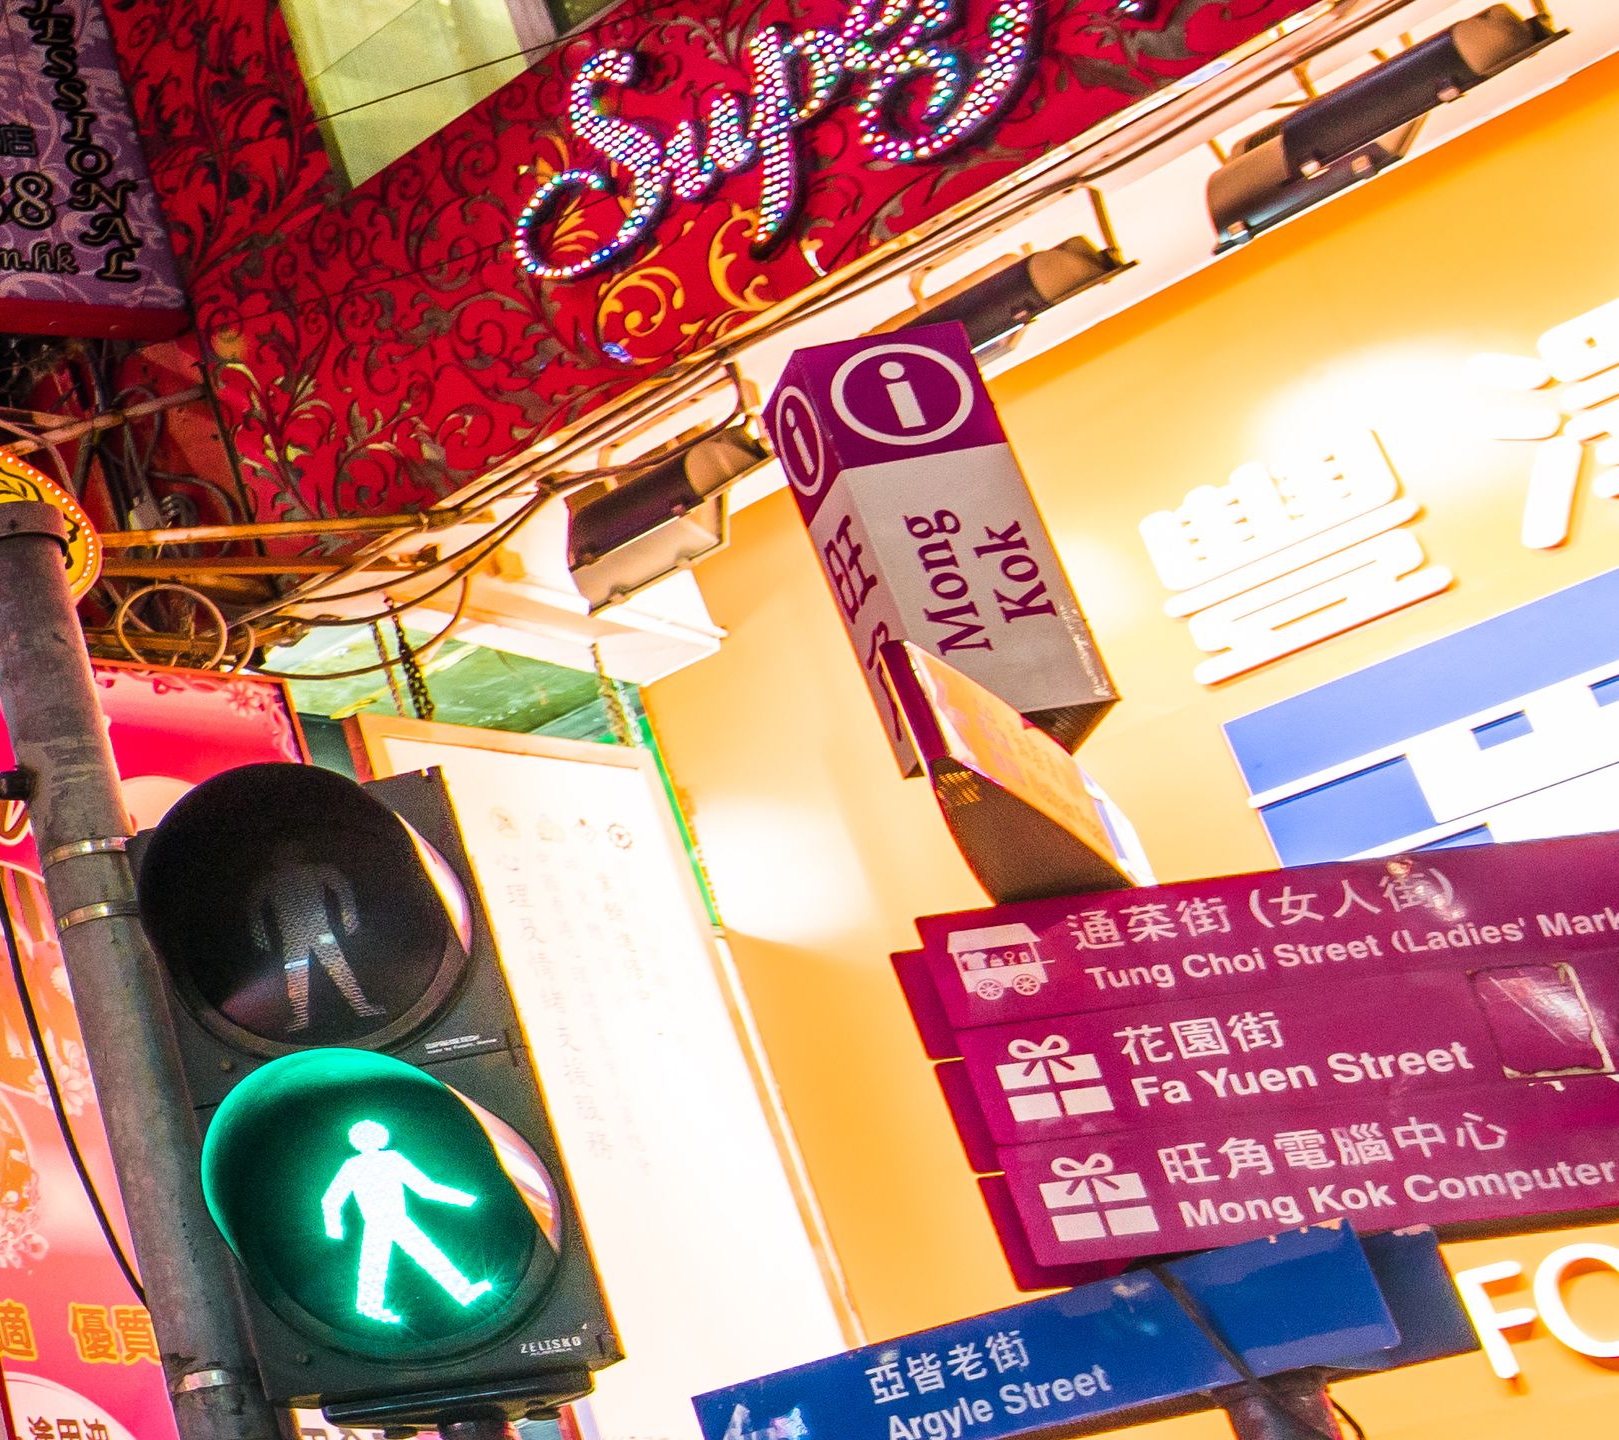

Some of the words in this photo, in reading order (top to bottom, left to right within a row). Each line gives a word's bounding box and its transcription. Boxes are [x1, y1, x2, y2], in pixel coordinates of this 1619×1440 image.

[902, 508, 993, 656] Mong
[975, 519, 1059, 622] Kok
[1083, 957, 1175, 992] Tung
[1180, 948, 1266, 985] Choi
[1273, 933, 1384, 971] Street
[1390, 917, 1530, 958] (Ladies'
[1113, 1011, 1285, 1065] 花園街
[1130, 1071, 1192, 1107] Fa
[1199, 1056, 1317, 1101] Yuen
[1327, 1039, 1475, 1085] Street
[1158, 1112, 1509, 1187] 旺角電腦中心
[1177, 1185, 1305, 1229] Mong
[1310, 1174, 1396, 1215] Kok
[863, 1329, 1031, 1407] 亞皆老街
[996, 1365, 1114, 1421] Street
